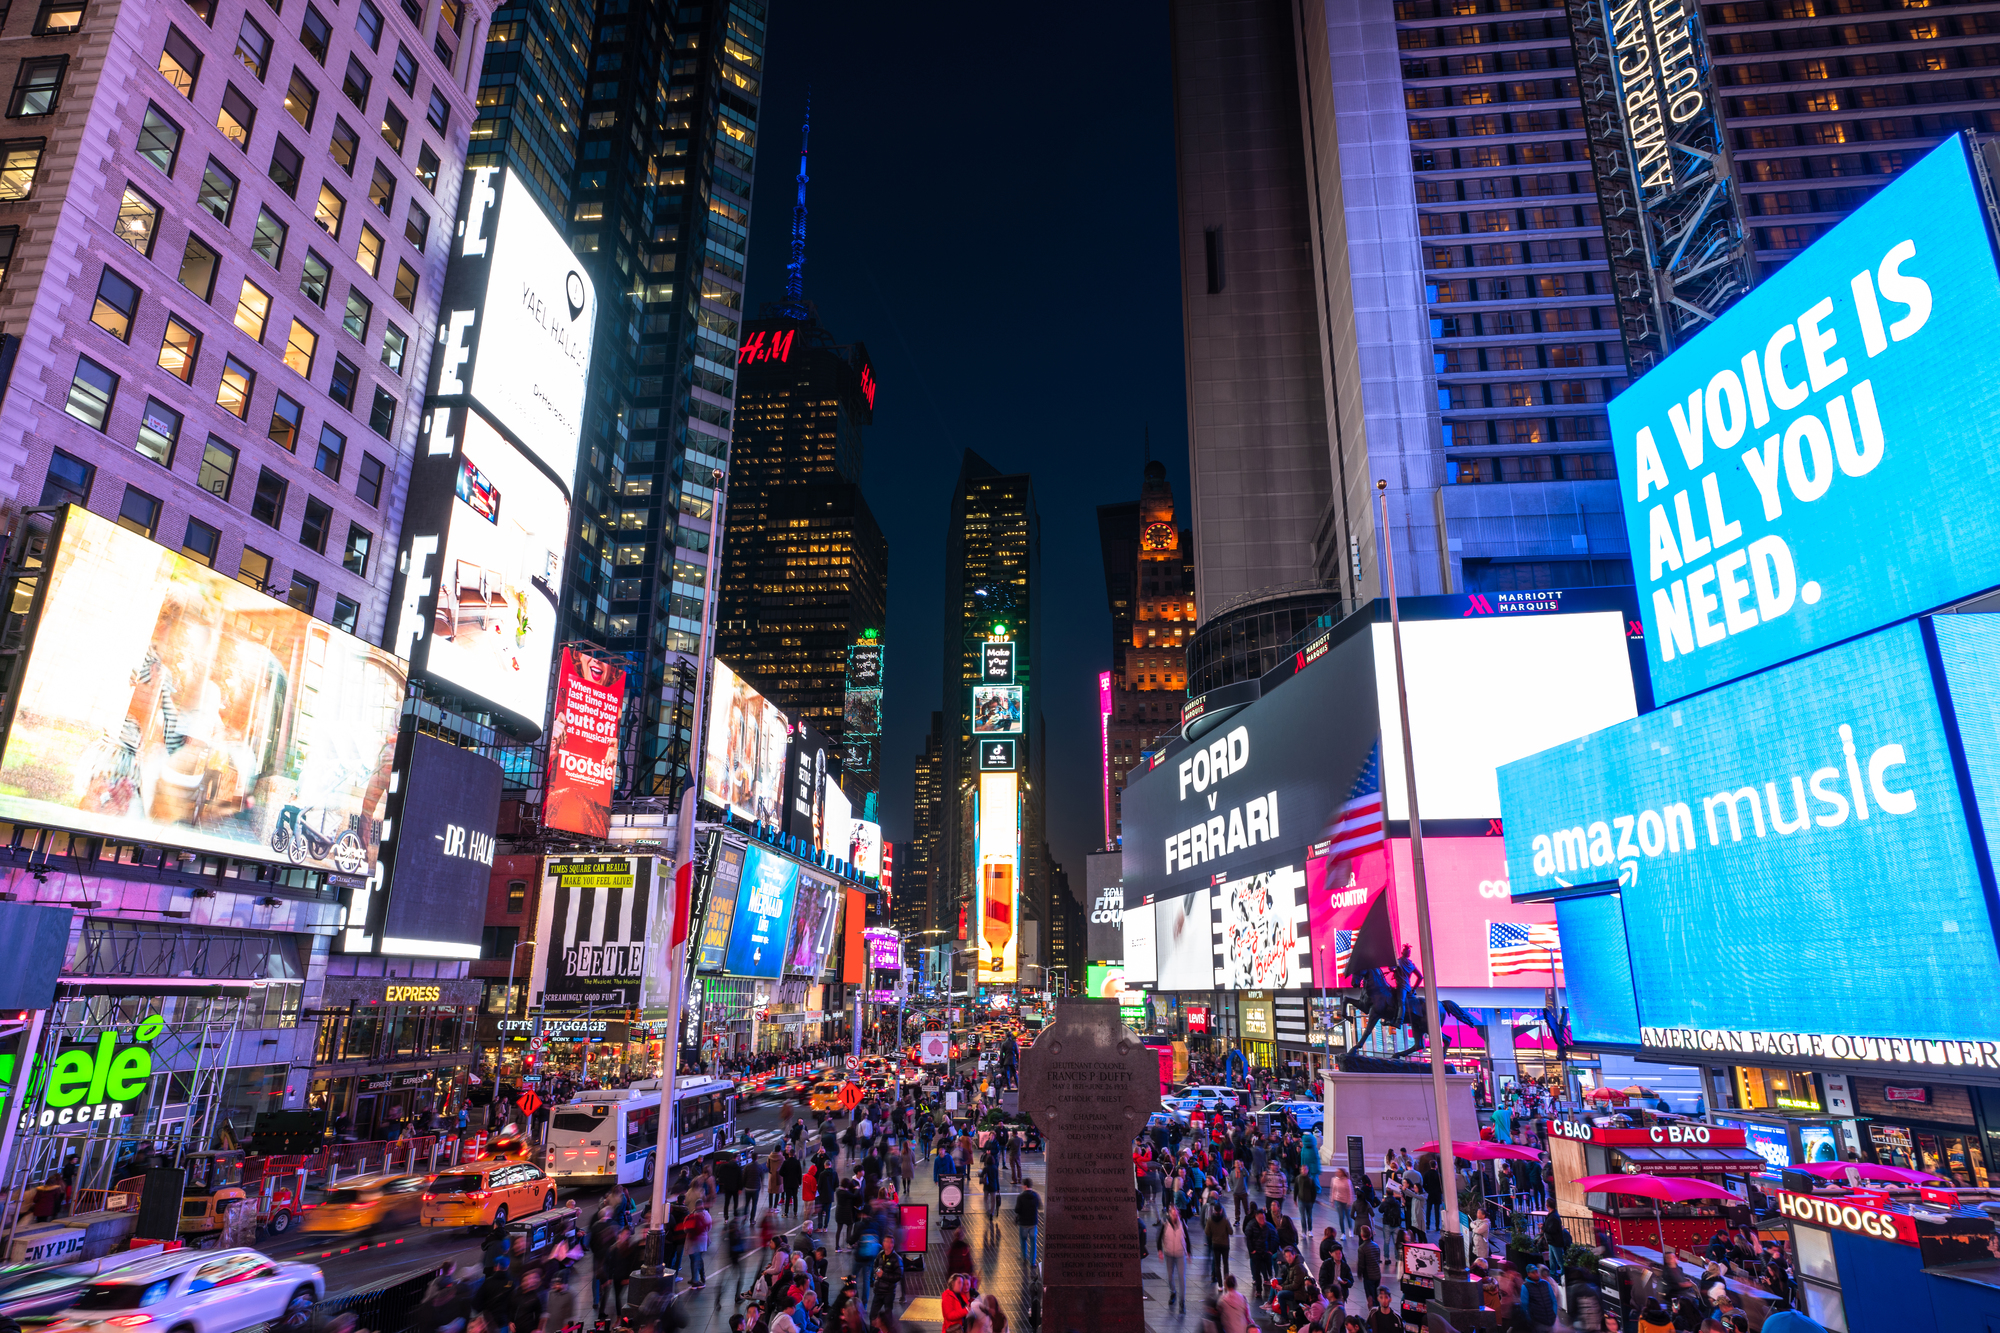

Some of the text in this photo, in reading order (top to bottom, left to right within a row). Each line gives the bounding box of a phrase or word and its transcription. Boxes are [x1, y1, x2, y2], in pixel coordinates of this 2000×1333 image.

[1610, 0, 1674, 188] AMERICAN
[738, 329, 795, 365] H&M
[1637, 240, 1932, 502] A VOICE IS
[1650, 380, 1884, 581] ALL YOU
[1499, 591, 1563, 602] MARRIOTT
[1653, 535, 1821, 662] NEED.
[1500, 602, 1557, 612] MARQUIS
[987, 649, 1010, 657] Make
[1306, 633, 1330, 654] MARRIOTT
[988, 658, 1008, 668] your
[1306, 644, 1328, 664] MARQUIS
[989, 667, 1008, 677] day.
[568, 688, 618, 713] last time you
[592, 687, 606, 699] was
[607, 693, 618, 704] the
[567, 698, 617, 722] laughed your
[566, 709, 616, 737] butt off
[566, 726, 575, 735] at
[559, 749, 613, 780] Tootsie
[1180, 726, 1249, 800] FORD
[1532, 724, 1917, 877] amazon music
[1166, 791, 1280, 874] FERRARI
[551, 863, 628, 875] TIMES SQUARE CAN REALLY
[563, 876, 632, 885] MAKE YOU FEEL ALIVE!
[711, 896, 734, 916] COME
[1331, 888, 1368, 909] COUNTRY
[703, 929, 728, 947] AWAY
[386, 985, 441, 1002] EXPRESS
[585, 993, 600, 1001] GOOD
[497, 1020, 607, 1032] GIFTS LUGGAGE
[1641, 1027, 1743, 1052] AMERICAN
[1749, 1032, 1825, 1056] EAGLE
[1052, 1062, 1126, 1070] LIEUTENANT COLONEL
[368, 1080, 393, 1089] EXPRESS
[402, 1076, 424, 1085] EXPRESS
[1047, 1072, 1133, 1081] FRANCIS DUFFY
[20, 1102, 123, 1129] SOCCER
[1553, 1119, 1592, 1140] C BAO
[1650, 1126, 1710, 1143] C BAO
[1778, 1192, 1898, 1240] HOTDOGS
[32, 1238, 77, 1260] NYPD
